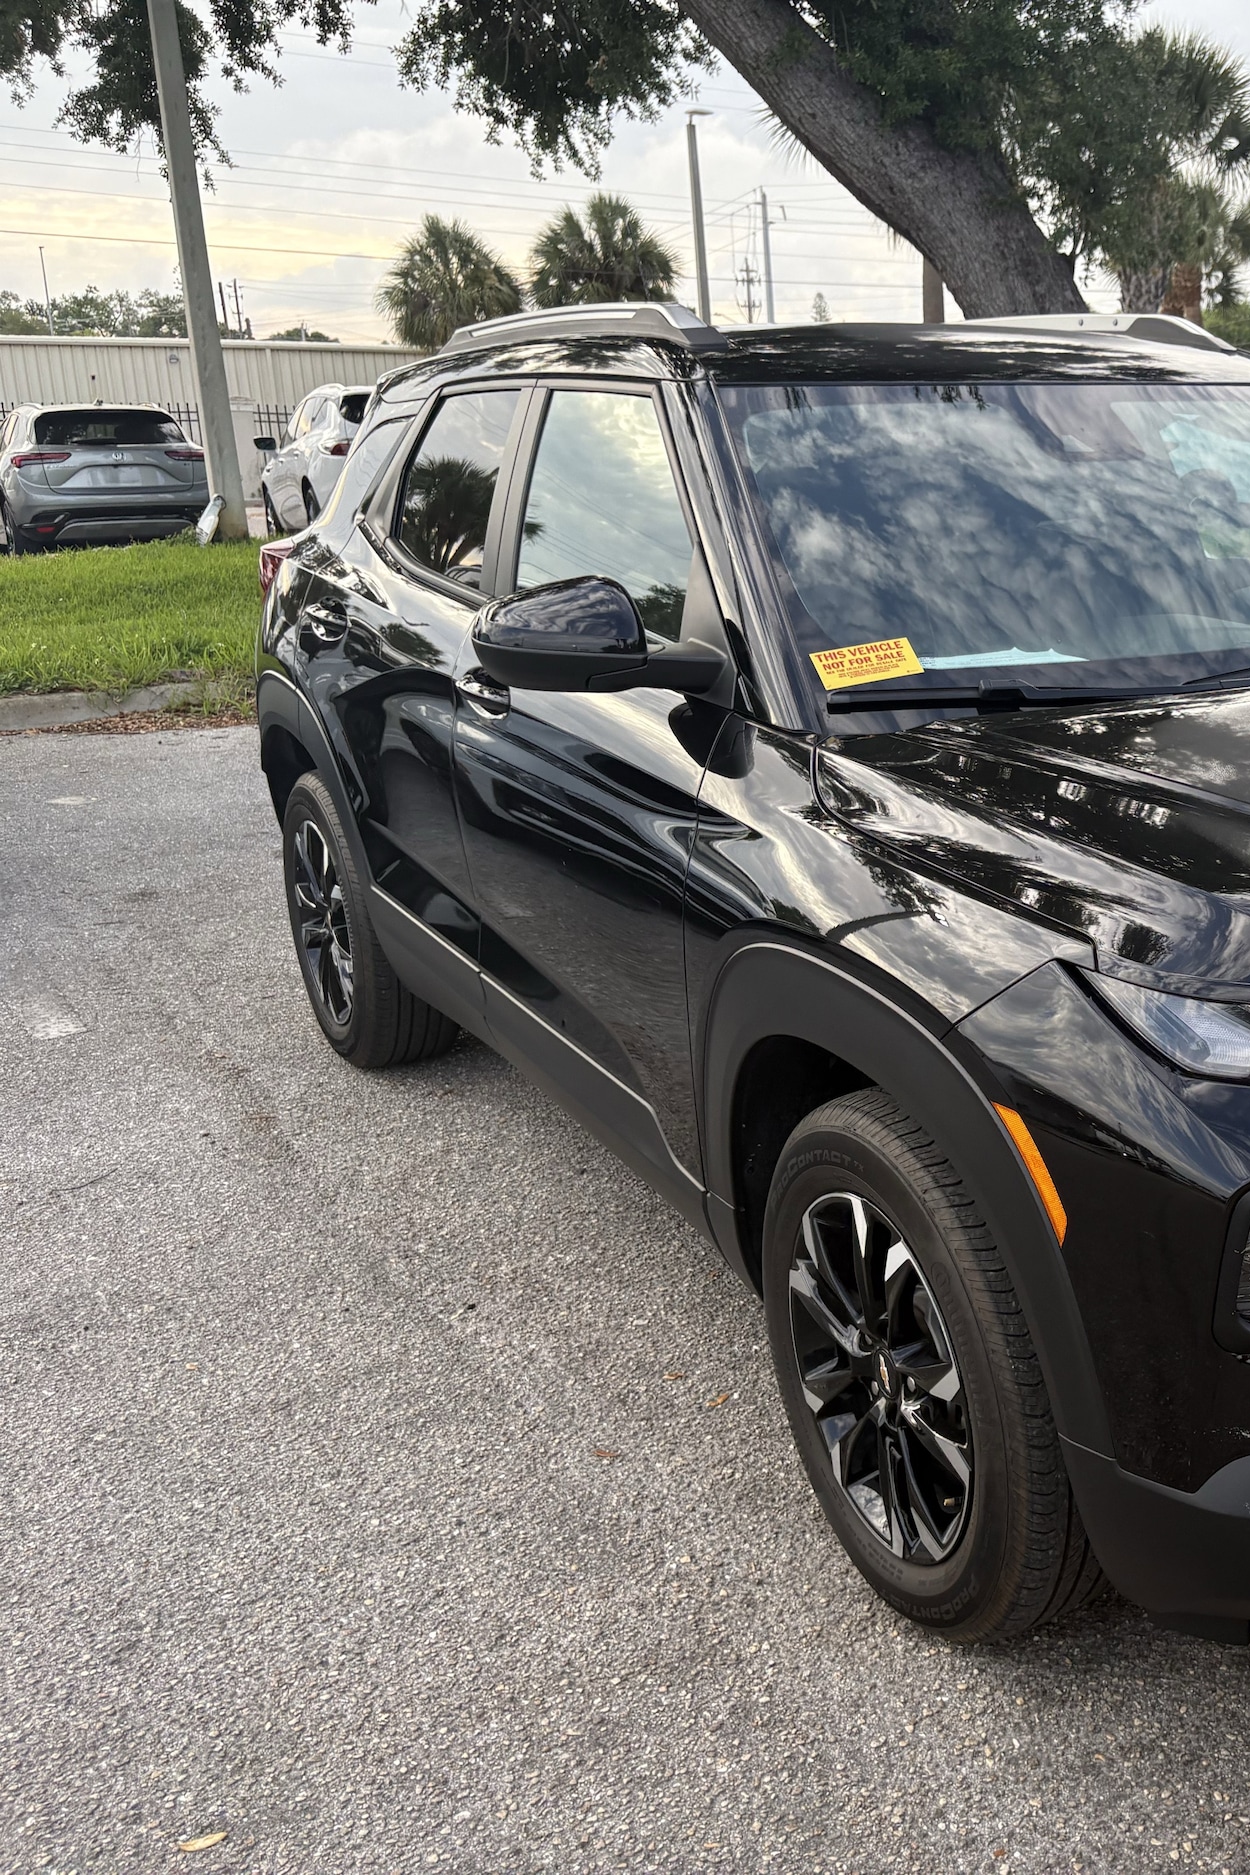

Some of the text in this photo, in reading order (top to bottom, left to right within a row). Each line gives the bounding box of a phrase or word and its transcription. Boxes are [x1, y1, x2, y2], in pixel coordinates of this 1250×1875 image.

[815, 640, 904, 663] THIS VEHICLE
[822, 660, 845, 671] NOT
[849, 656, 872, 667] FOR
[875, 651, 905, 662] SALE
